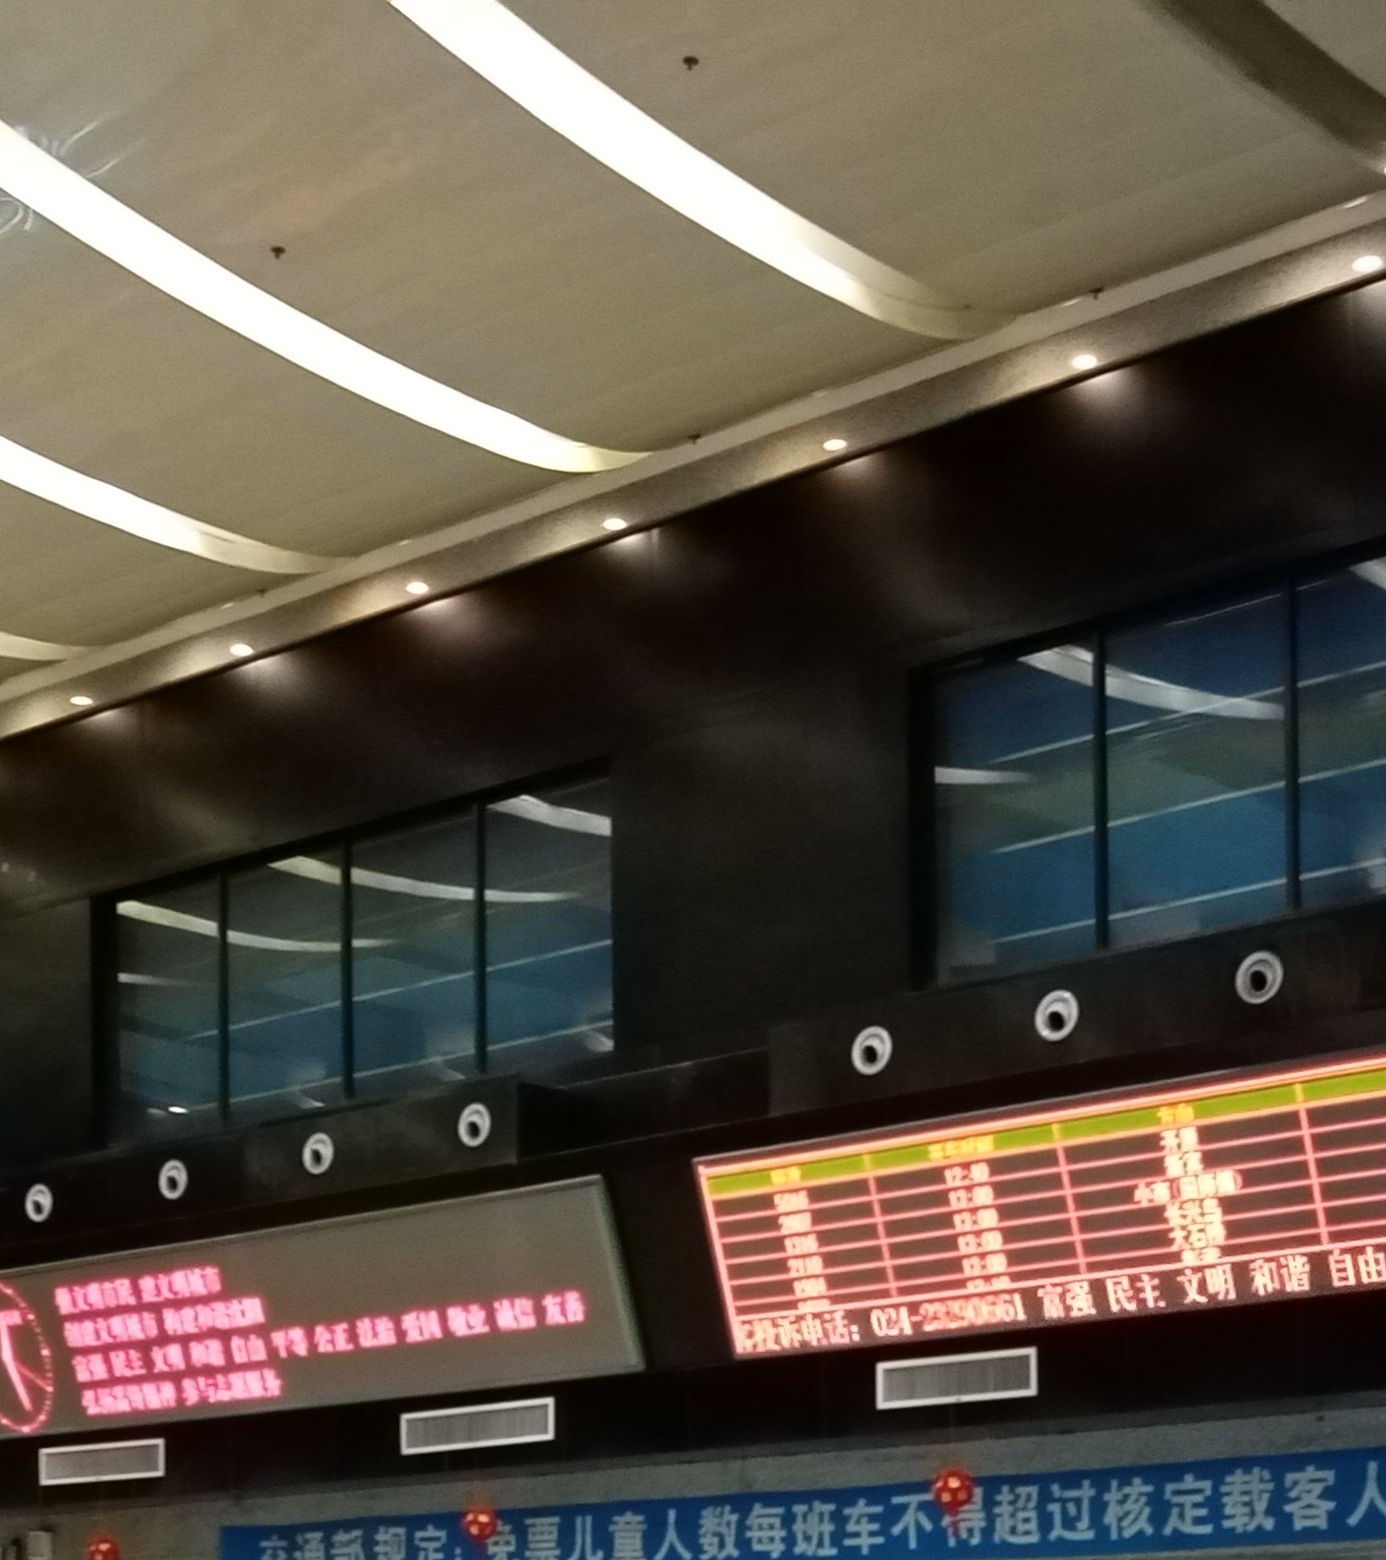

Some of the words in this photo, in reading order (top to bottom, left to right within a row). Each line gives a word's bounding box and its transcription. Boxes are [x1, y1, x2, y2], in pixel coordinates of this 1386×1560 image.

[1036, 1280, 1097, 1320] 富强
[1105, 1273, 1166, 1312] 民主
[1177, 1263, 1237, 1304] 文明
[1248, 1253, 1311, 1297] 和谐
